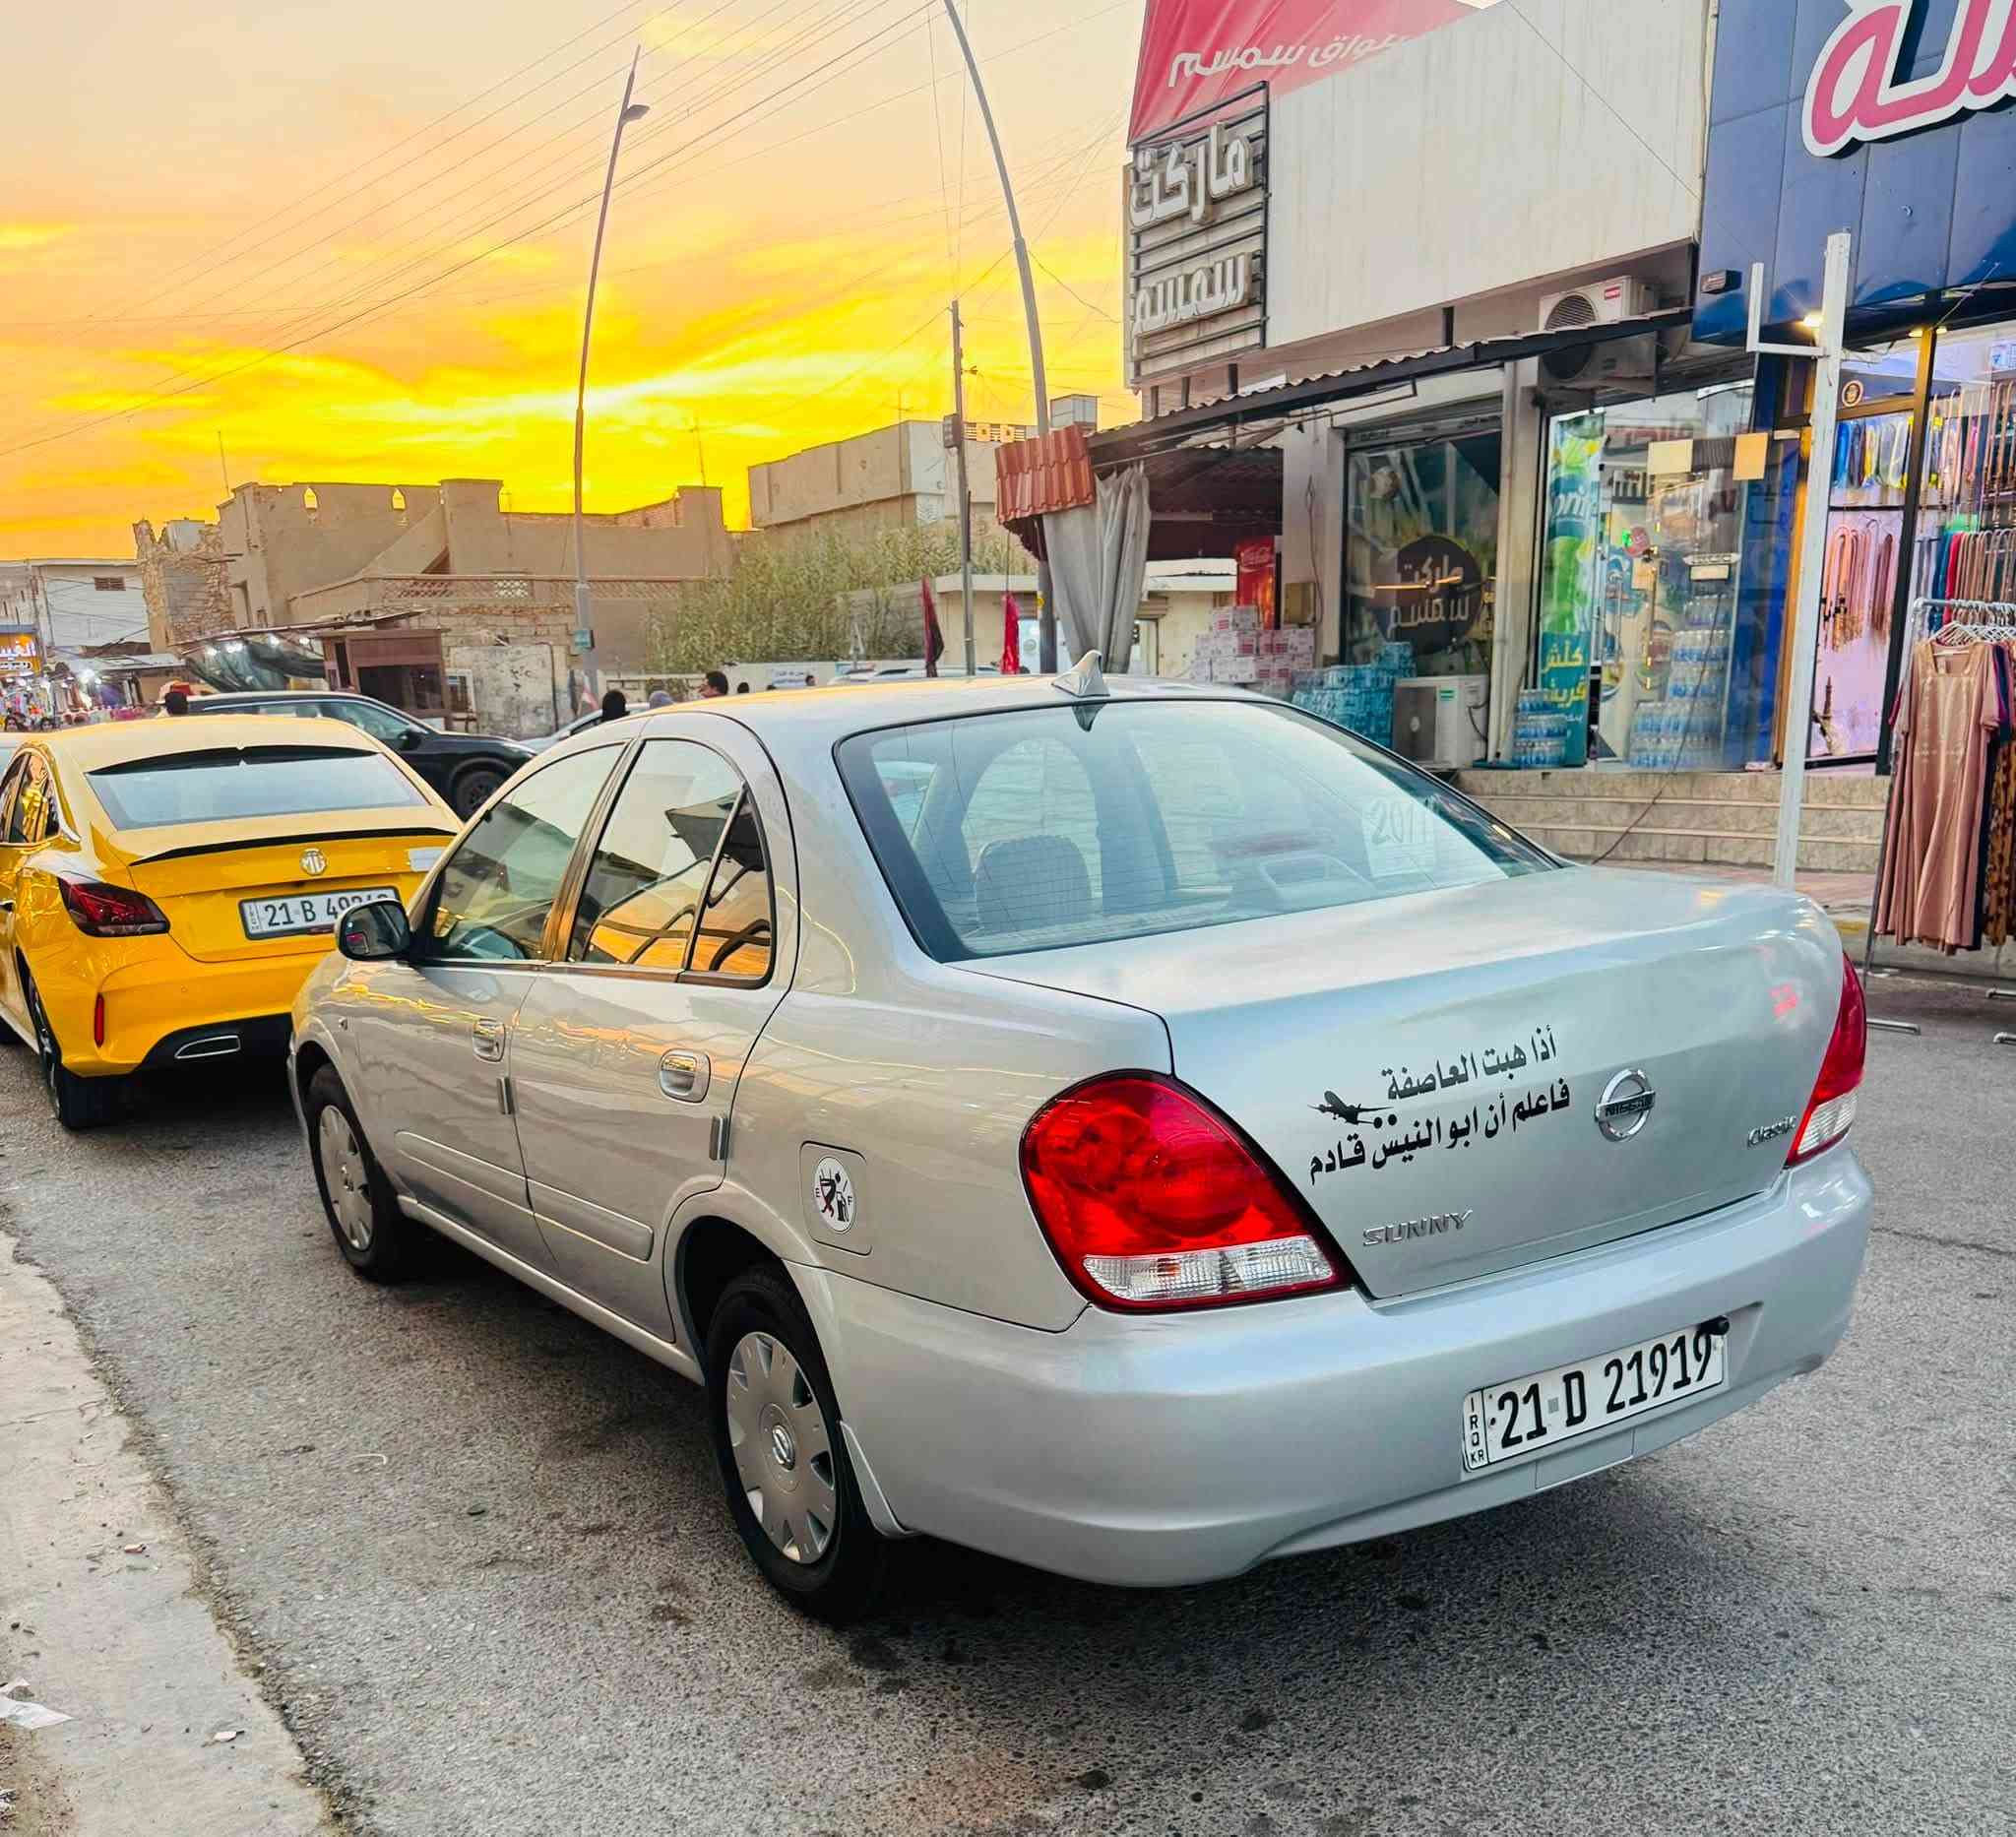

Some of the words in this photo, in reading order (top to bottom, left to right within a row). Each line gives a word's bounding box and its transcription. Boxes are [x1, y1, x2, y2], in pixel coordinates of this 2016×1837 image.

[1130, 120, 1252, 227] ماركت
[1132, 252, 1250, 335] سمسم
[265, 903, 294, 927] 21
[300, 900, 316, 922] B
[1381, 1051, 1478, 1100] العاصفة
[1481, 1045, 1527, 1080] هبت
[1484, 1092, 1506, 1138] أن
[1512, 1077, 1570, 1132] فاعلم
[1604, 1095, 1654, 1117] NISSAN
[1309, 1132, 1366, 1185] قادم
[1362, 1209, 1474, 1247] SUNNY
[1497, 1382, 1547, 1449] 21
[1561, 1369, 1587, 1427] D
[1604, 1329, 1712, 1415] 21919
